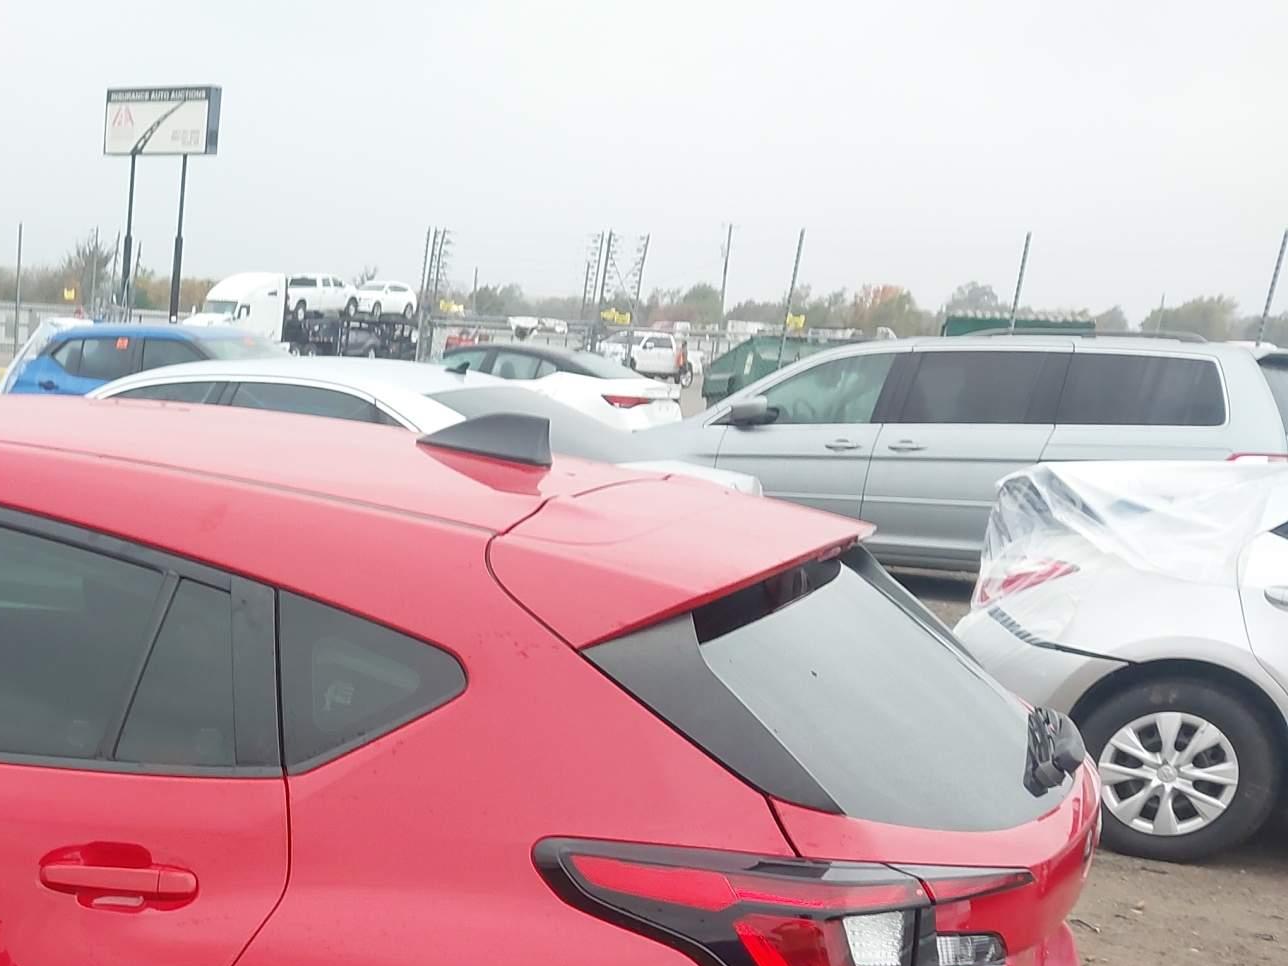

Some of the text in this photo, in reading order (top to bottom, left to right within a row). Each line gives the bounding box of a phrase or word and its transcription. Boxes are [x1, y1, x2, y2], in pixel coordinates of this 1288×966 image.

[110, 89, 206, 102] INSURANCE AUTO AUCTIONS
